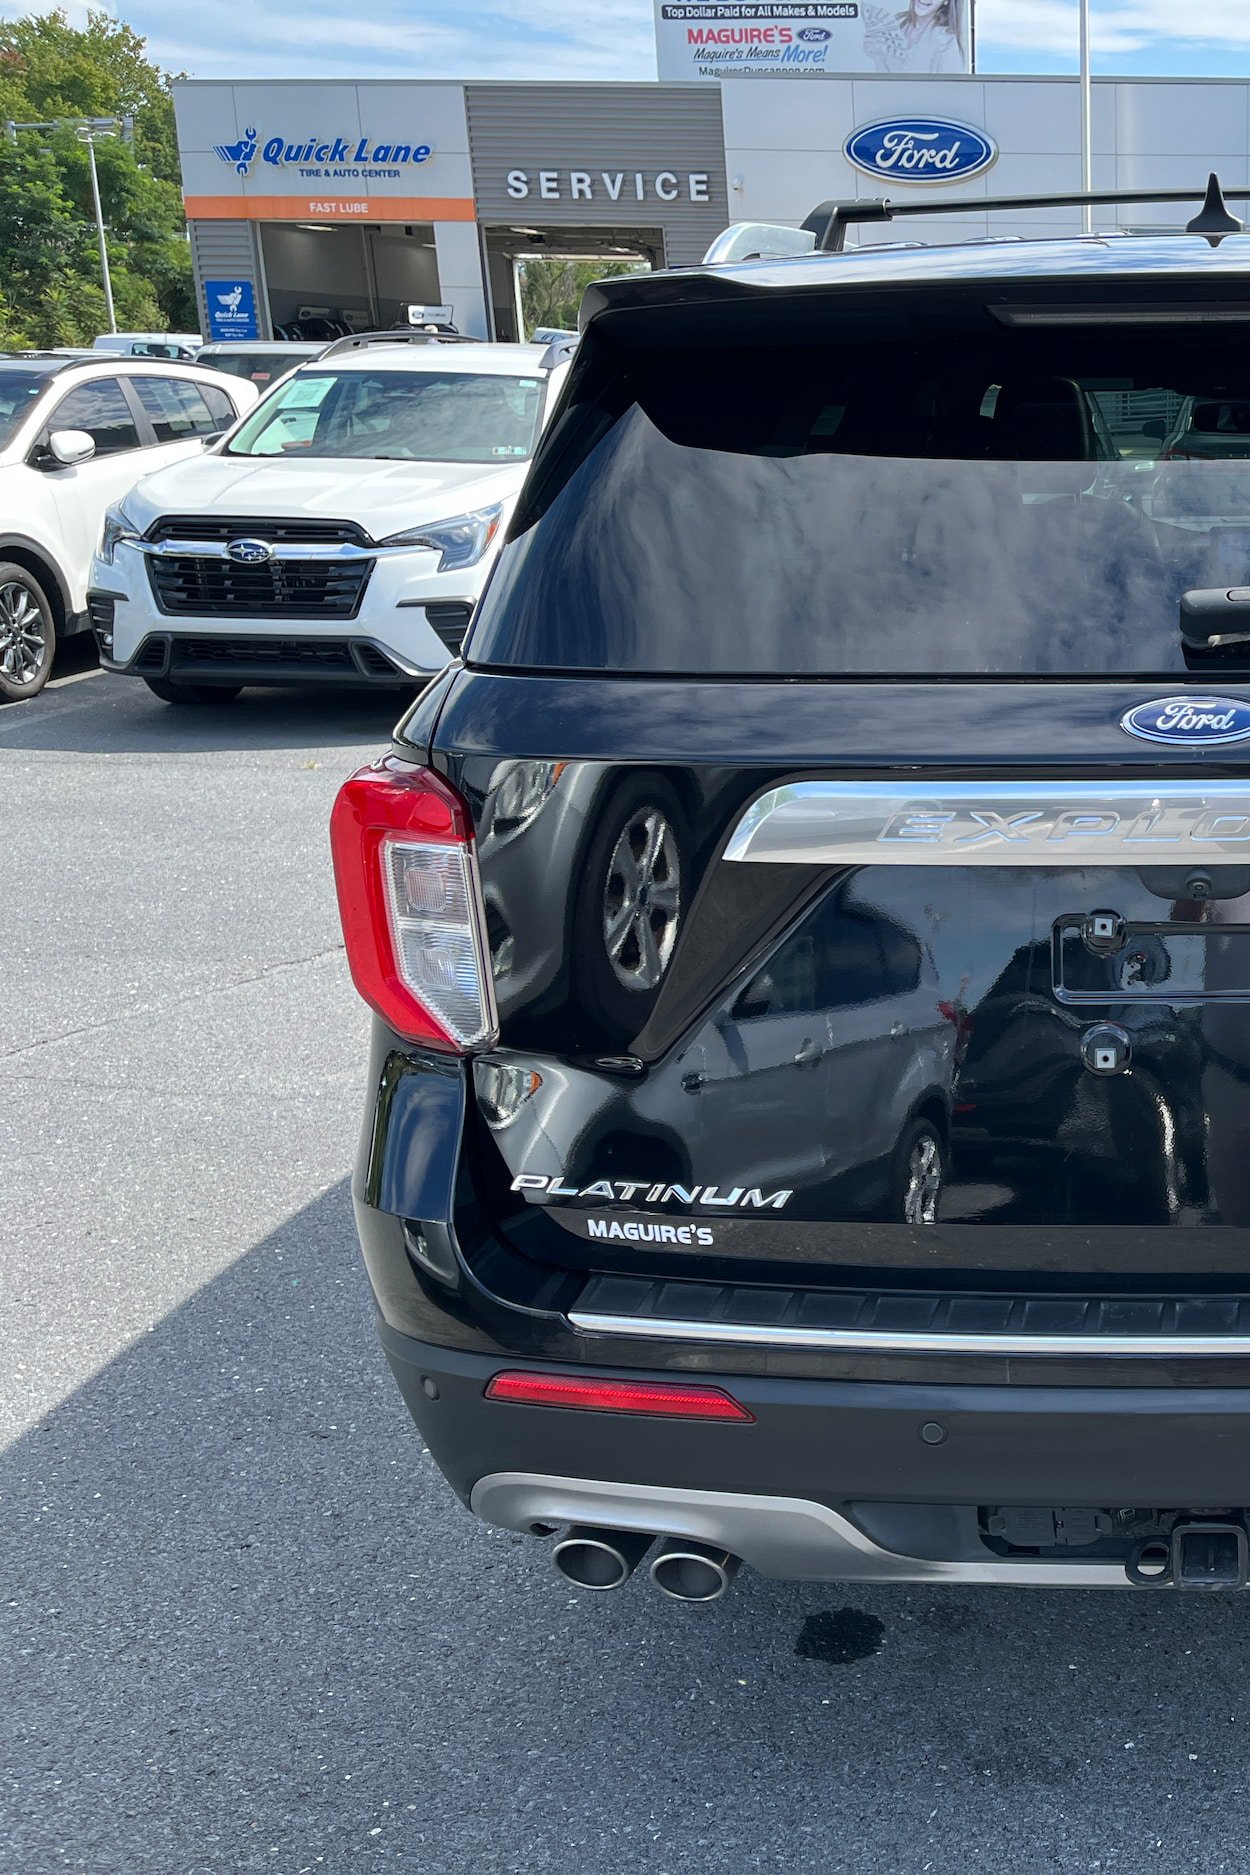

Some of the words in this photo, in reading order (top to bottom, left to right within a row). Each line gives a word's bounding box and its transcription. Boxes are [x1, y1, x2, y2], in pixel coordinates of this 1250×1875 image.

[665, 6, 684, 18] Top
[686, 6, 716, 17] Dollar
[717, 6, 740, 17] Paid
[741, 6, 756, 16] for
[758, 6, 771, 16] All
[773, 6, 805, 16] Makes
[807, 5, 815, 16] &
[817, 4, 855, 16] Models
[687, 25, 793, 44] MAGUIRE'S
[802, 29, 826, 41] Ford
[693, 47, 743, 63] Maguire's
[746, 47, 781, 59] Means
[781, 45, 829, 63] More!
[262, 137, 346, 165] Quick
[353, 138, 431, 163] Lane
[874, 130, 962, 170] Ford
[299, 169, 322, 178] TIRE
[324, 169, 330, 177] &
[333, 169, 360, 178] AUTO
[361, 169, 401, 178] CENTER
[507, 169, 710, 202] SERVICE
[309, 203, 338, 213] FAST
[339, 203, 368, 214] LUBE
[1155, 701, 1236, 733] Ford
[509, 1174, 794, 1210] PLATINUM
[587, 1218, 715, 1245] MAGUIRE'S
